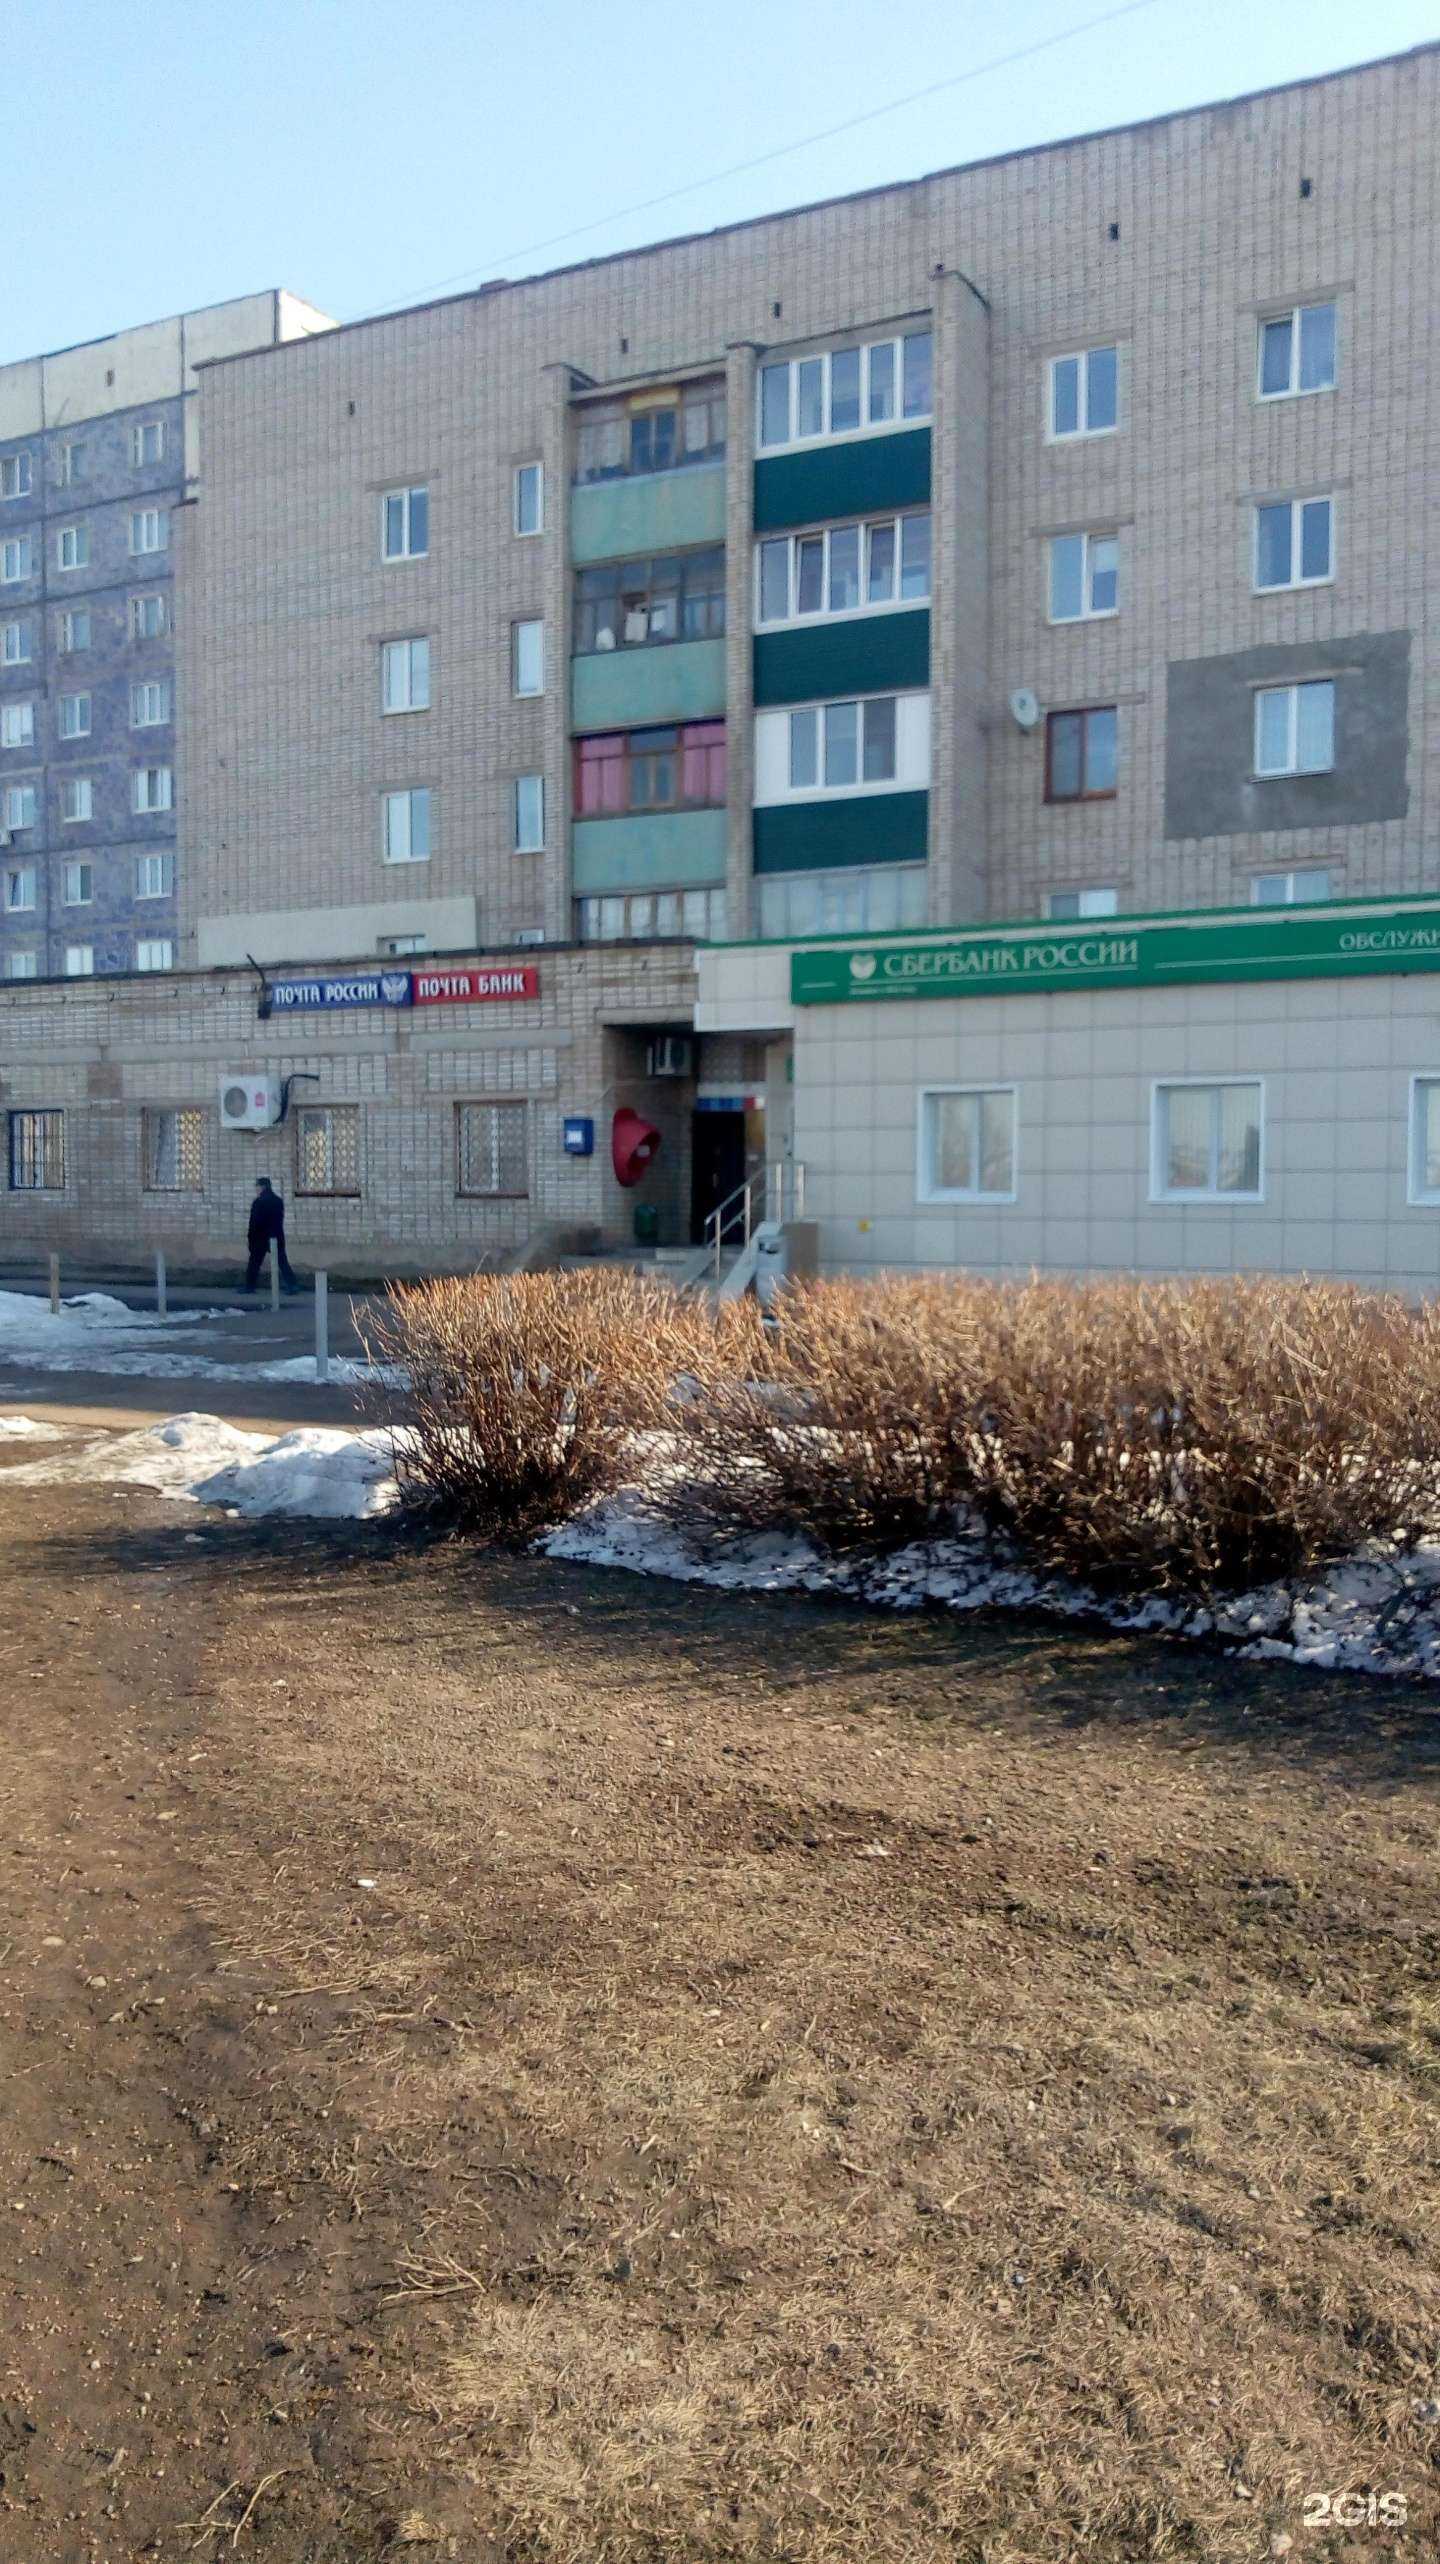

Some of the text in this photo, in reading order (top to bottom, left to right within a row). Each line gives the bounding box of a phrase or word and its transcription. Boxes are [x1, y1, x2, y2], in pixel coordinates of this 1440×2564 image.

[883, 939, 1138, 977] СБЕРБАНК РОССИИ
[275, 982, 378, 1004] ПОЧТА РОССИИ
[419, 973, 525, 997] ПОЧТА БАНК
